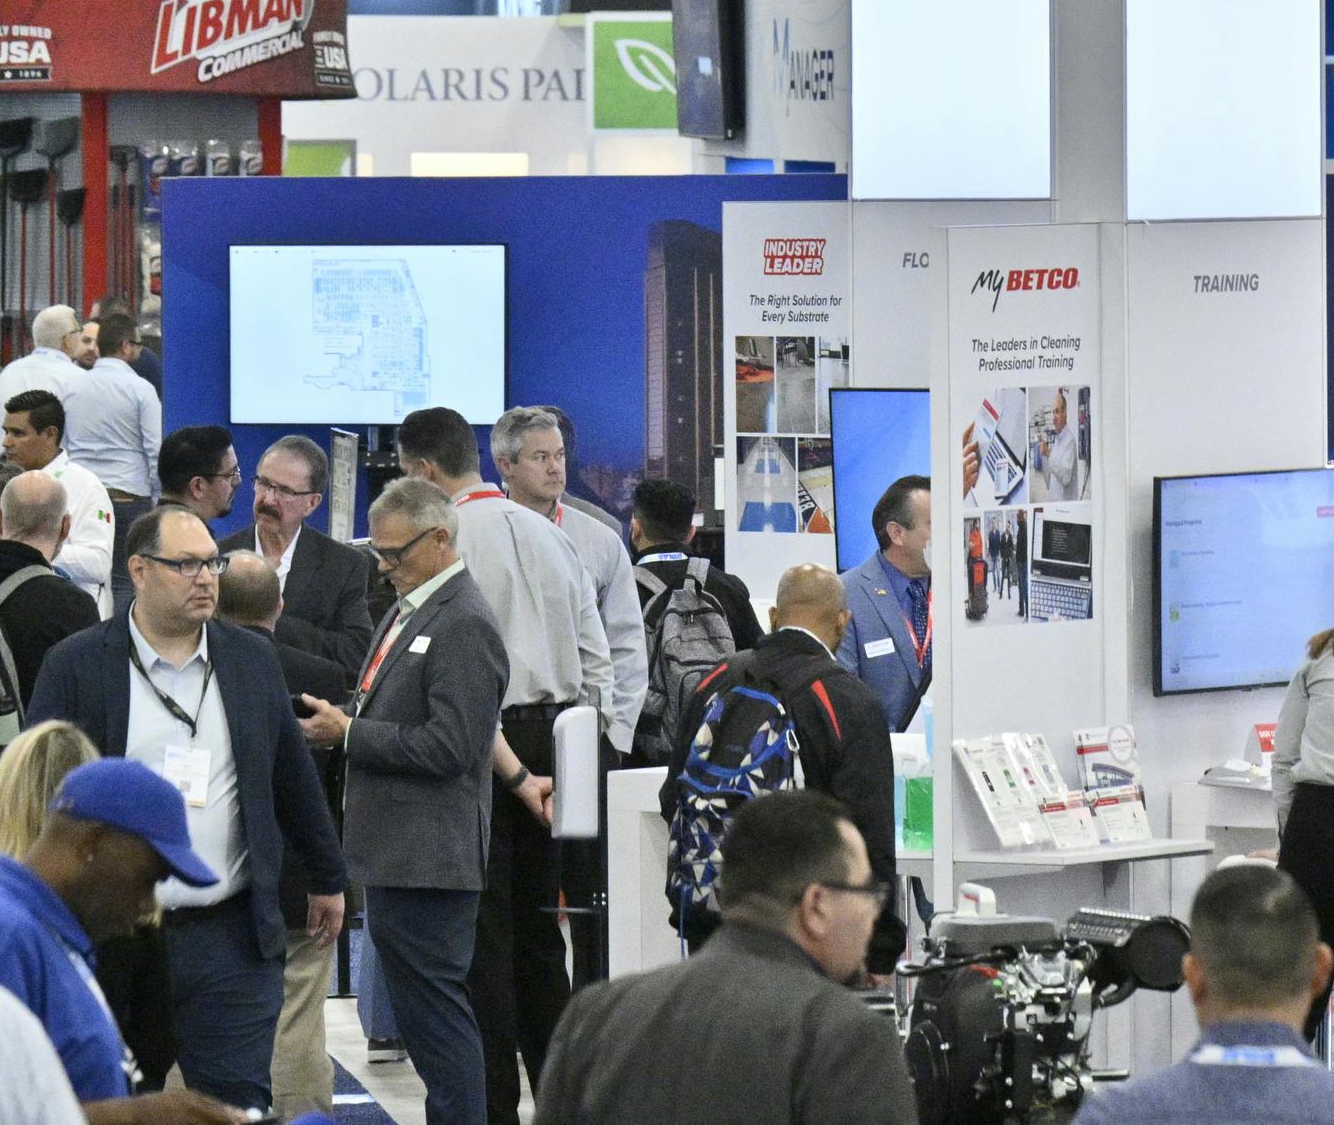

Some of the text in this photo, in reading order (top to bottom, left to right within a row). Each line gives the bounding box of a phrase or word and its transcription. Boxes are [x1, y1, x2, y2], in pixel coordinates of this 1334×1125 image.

[11, 25, 53, 40] OWNED
[199, 31, 305, 83] COMMERCIAL
[764, 239, 826, 257] INDUSTRY
[764, 257, 824, 275] LEADER
[971, 267, 1079, 313] My BETCO
[1192, 273, 1260, 294] TRAINING
[750, 294, 843, 309] The Right Solution for
[762, 310, 830, 325] Every Substrate
[972, 334, 1081, 353] The Leaders in Cleaning
[978, 354, 1075, 372] Professional Training
